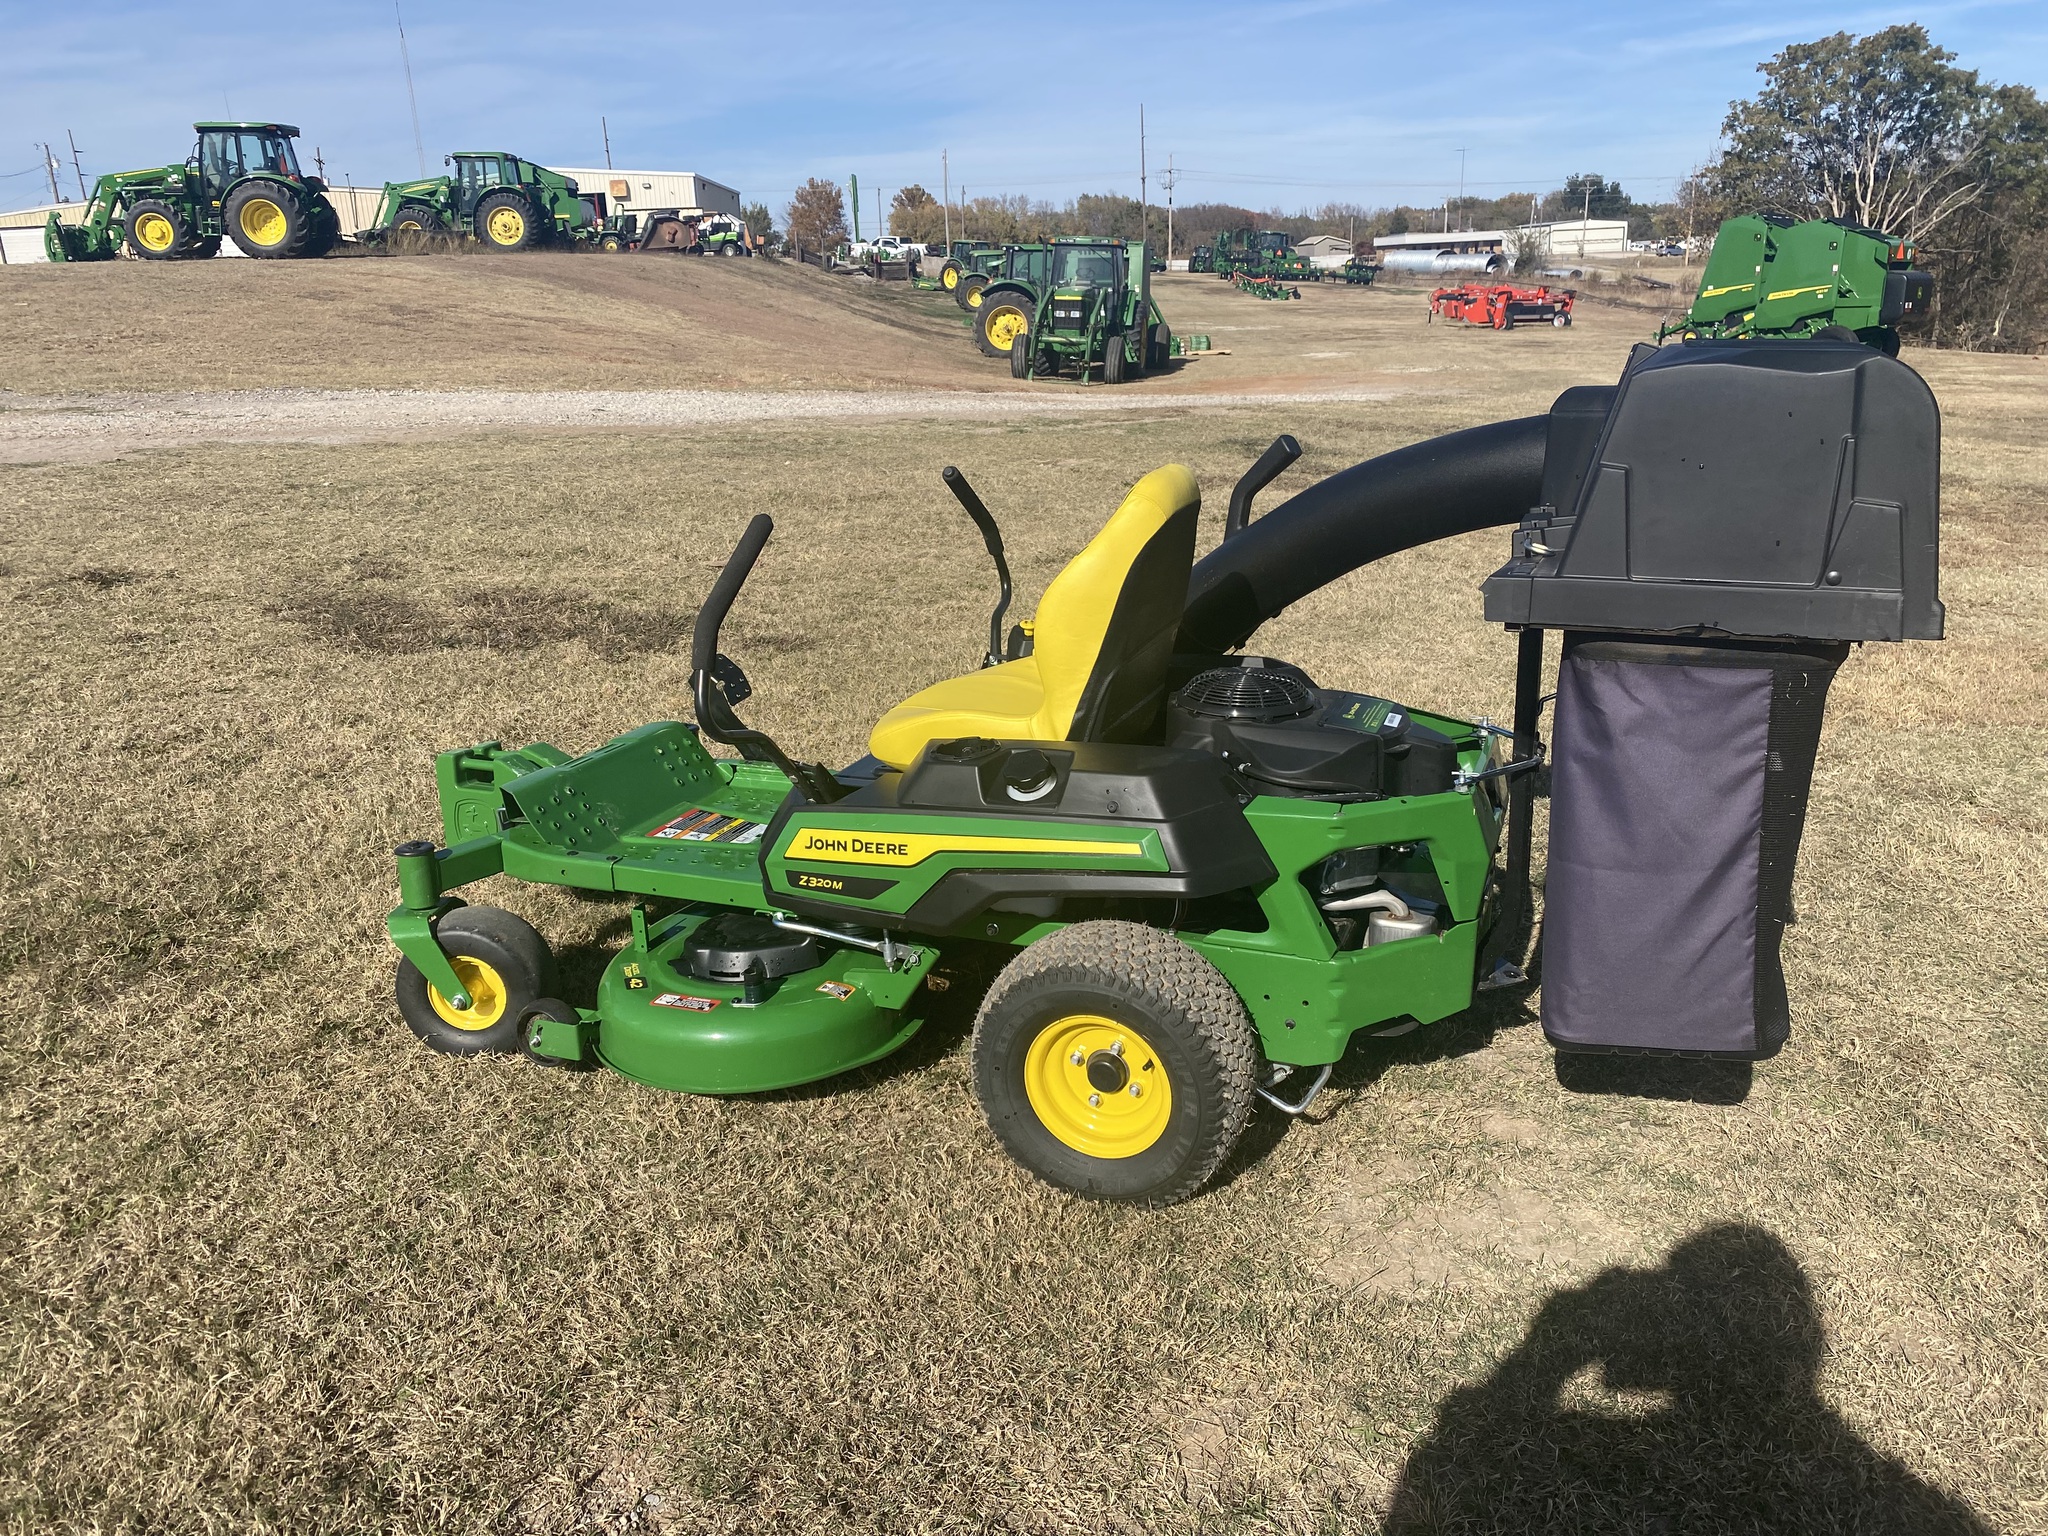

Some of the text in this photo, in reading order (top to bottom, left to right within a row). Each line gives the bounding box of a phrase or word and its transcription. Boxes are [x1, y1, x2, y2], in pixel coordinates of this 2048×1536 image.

[804, 836, 909, 856] JOHN DEERE
[798, 875, 843, 890] Z320M
[629, 978, 643, 989] 42
